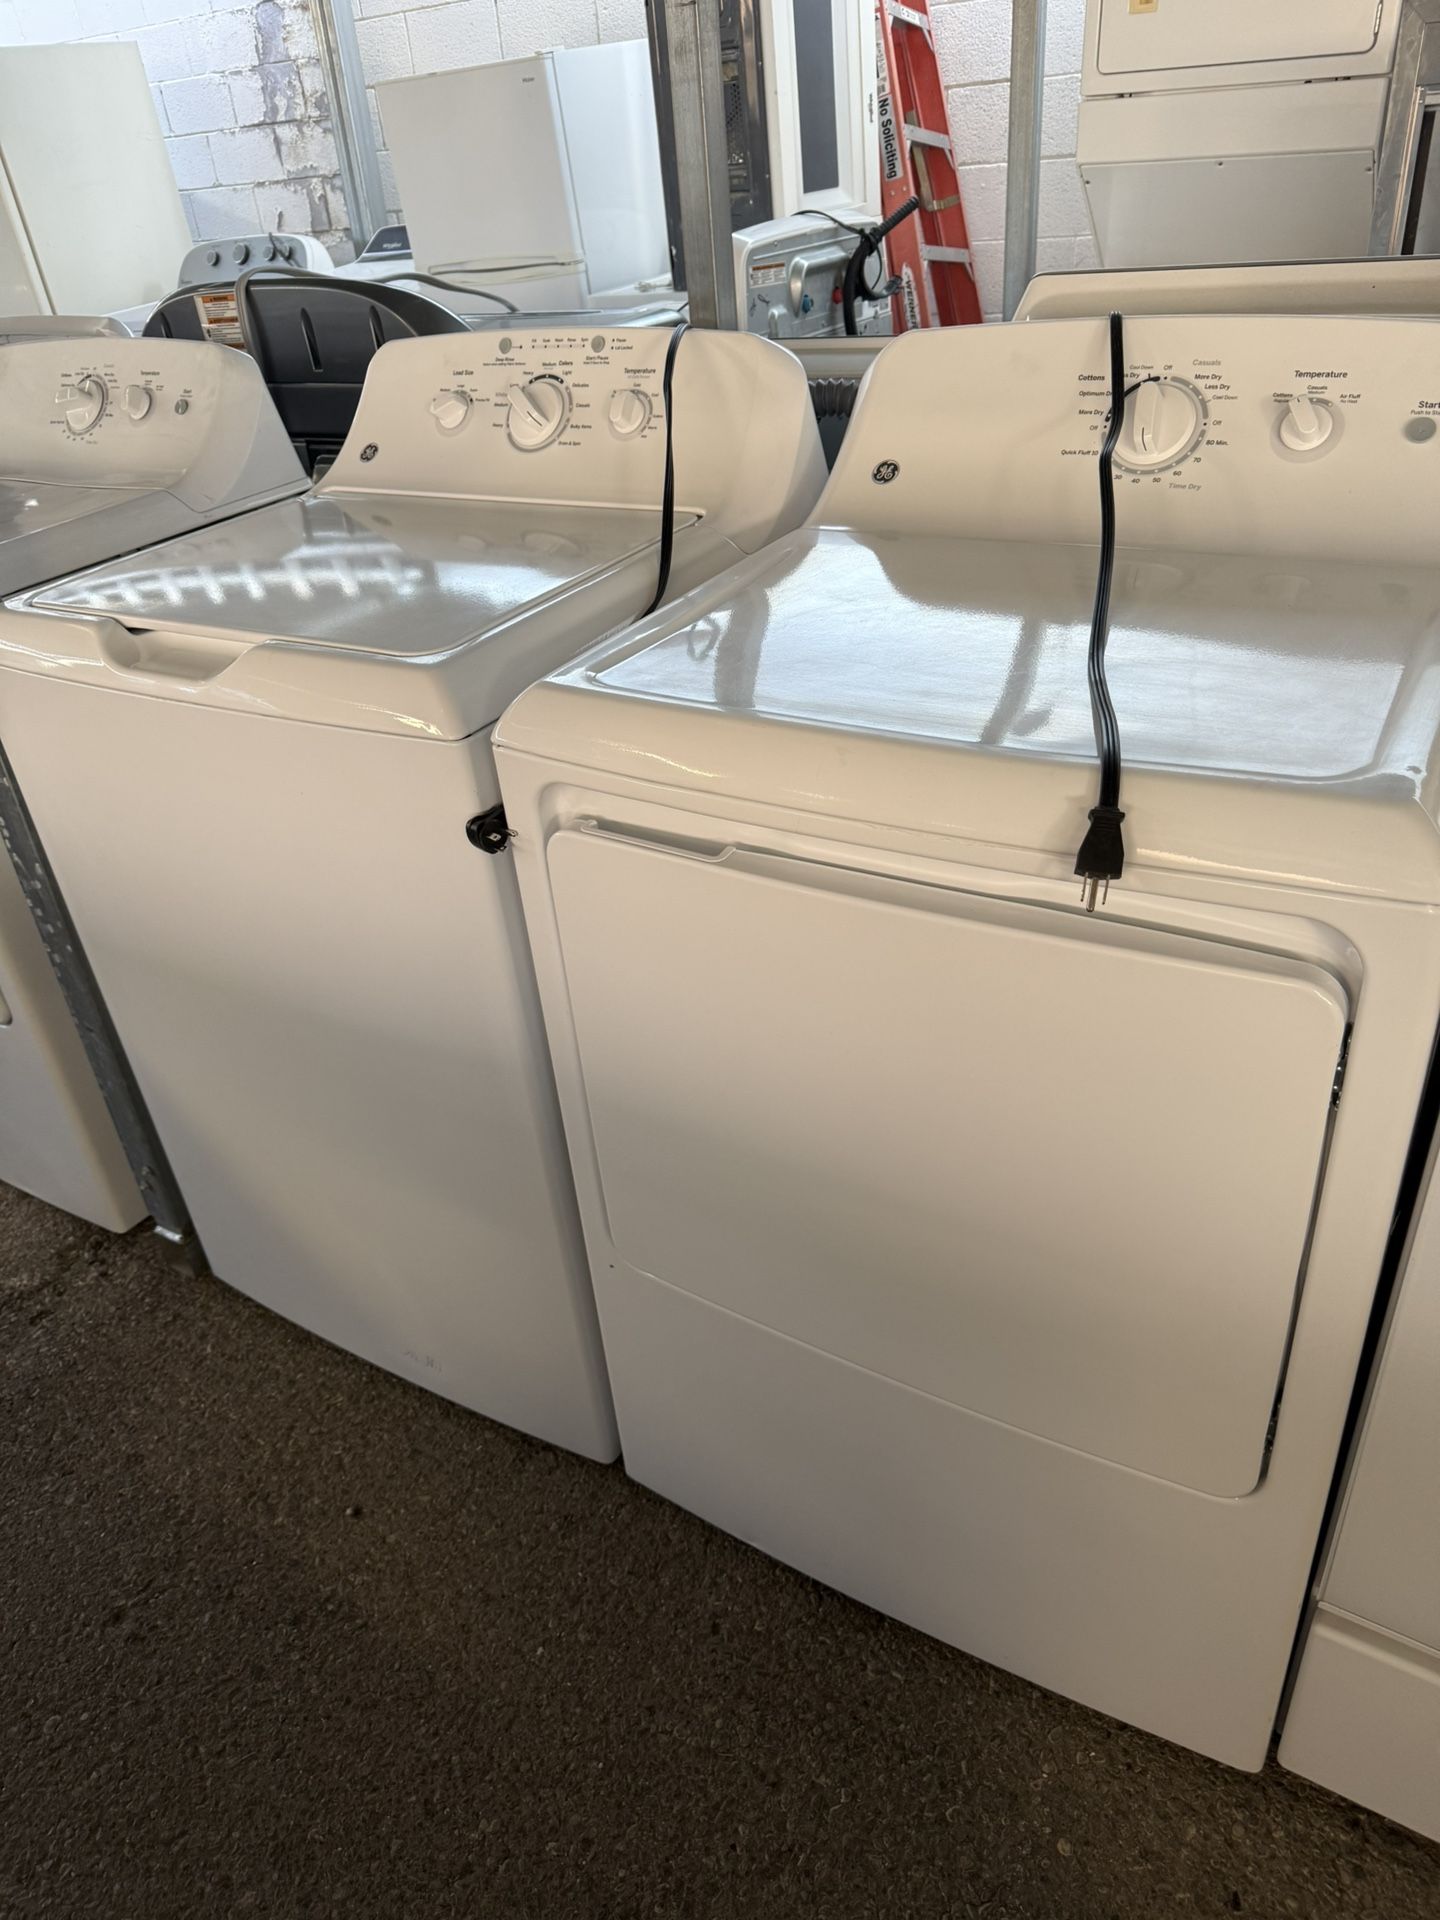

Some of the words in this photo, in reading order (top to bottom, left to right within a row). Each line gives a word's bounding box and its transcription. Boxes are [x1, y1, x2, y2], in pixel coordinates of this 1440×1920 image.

[879, 97, 889, 116] No
[882, 119, 898, 178] Soliciting
[1295, 370, 1348, 379] Temperature
[872, 460, 900, 485] GE
[1188, 483, 1202, 491] Dry
